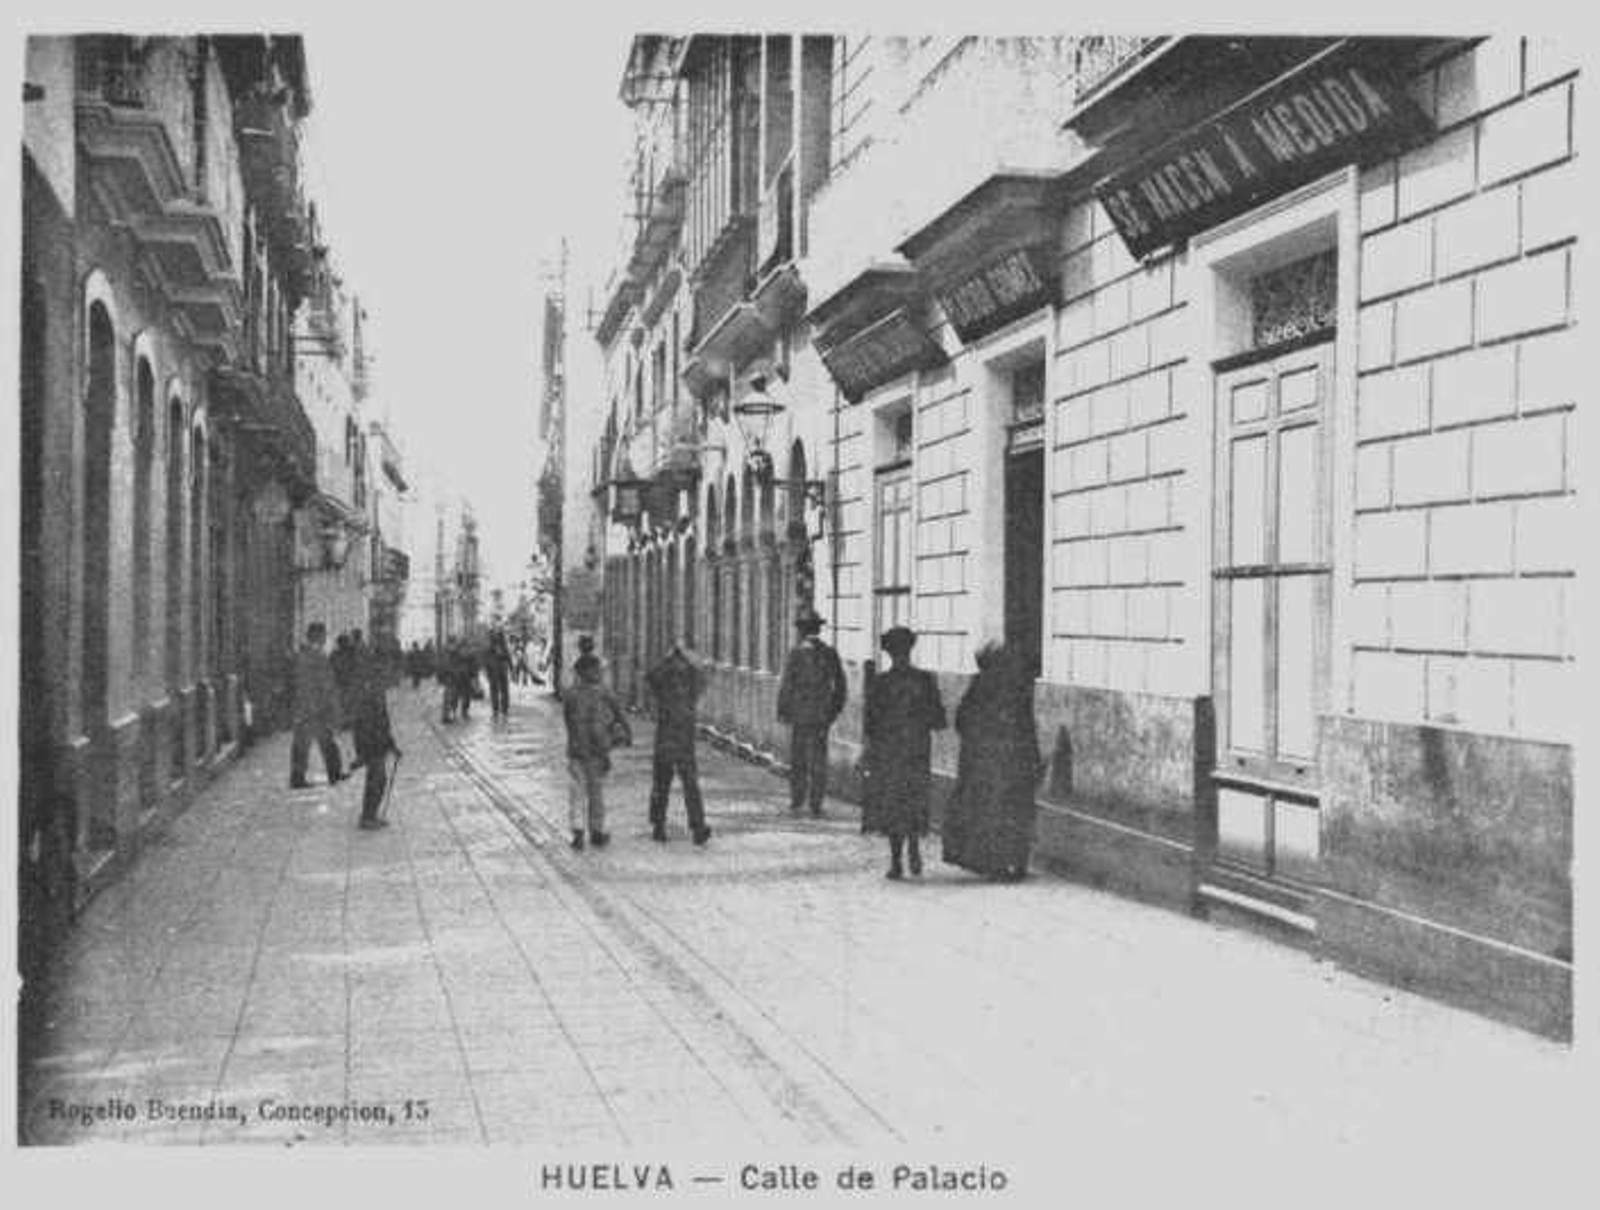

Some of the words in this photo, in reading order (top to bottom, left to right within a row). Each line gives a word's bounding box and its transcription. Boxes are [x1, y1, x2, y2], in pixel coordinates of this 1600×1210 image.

[1108, 189, 1150, 238] SE
[1139, 148, 1232, 221] HACEN
[1252, 68, 1390, 163] MEDIDA
